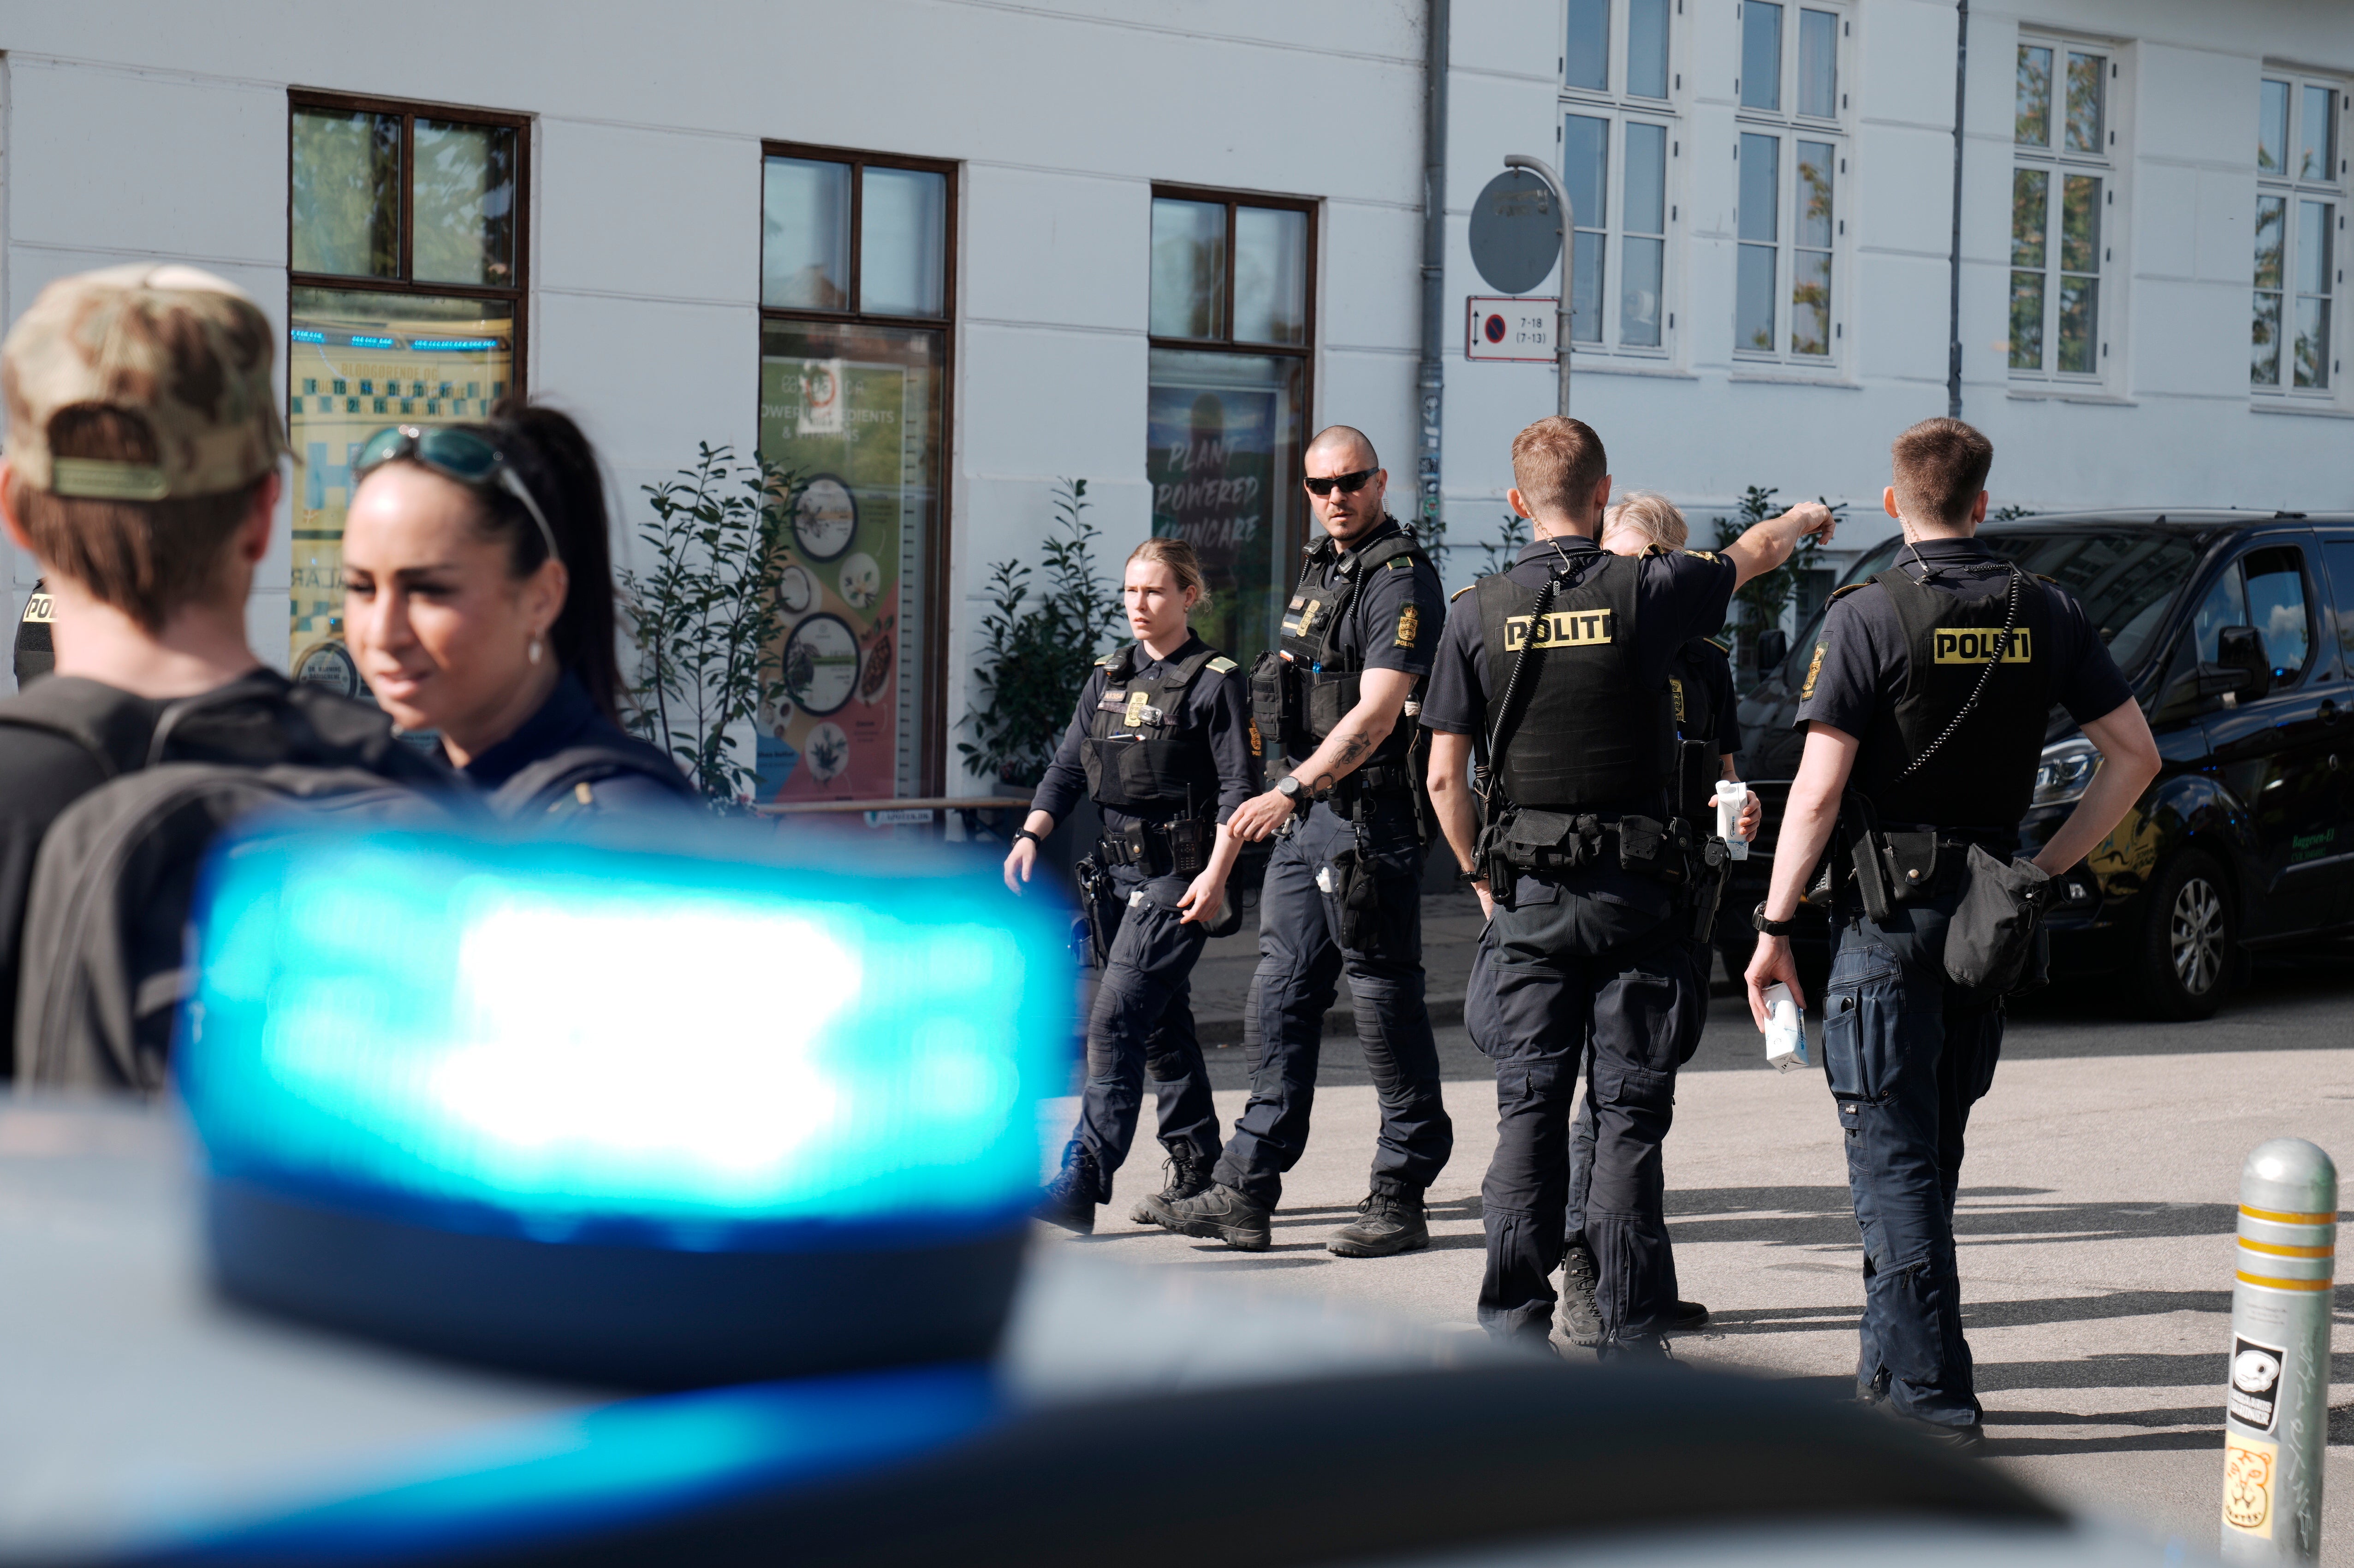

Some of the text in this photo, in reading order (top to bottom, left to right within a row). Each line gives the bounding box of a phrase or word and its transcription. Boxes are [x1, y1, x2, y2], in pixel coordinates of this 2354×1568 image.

[1521, 317, 1542, 328] 7-18
[1516, 333, 1546, 345] (7-13)
[341, 363, 439, 380] BLØDGØRENDE OG
[782, 427, 791, 439] &
[1168, 437, 1239, 472] PLANT
[1156, 477, 1259, 512] POWERED
[1507, 614, 1612, 646] POLITI
[1395, 639, 1415, 648] POLITI
